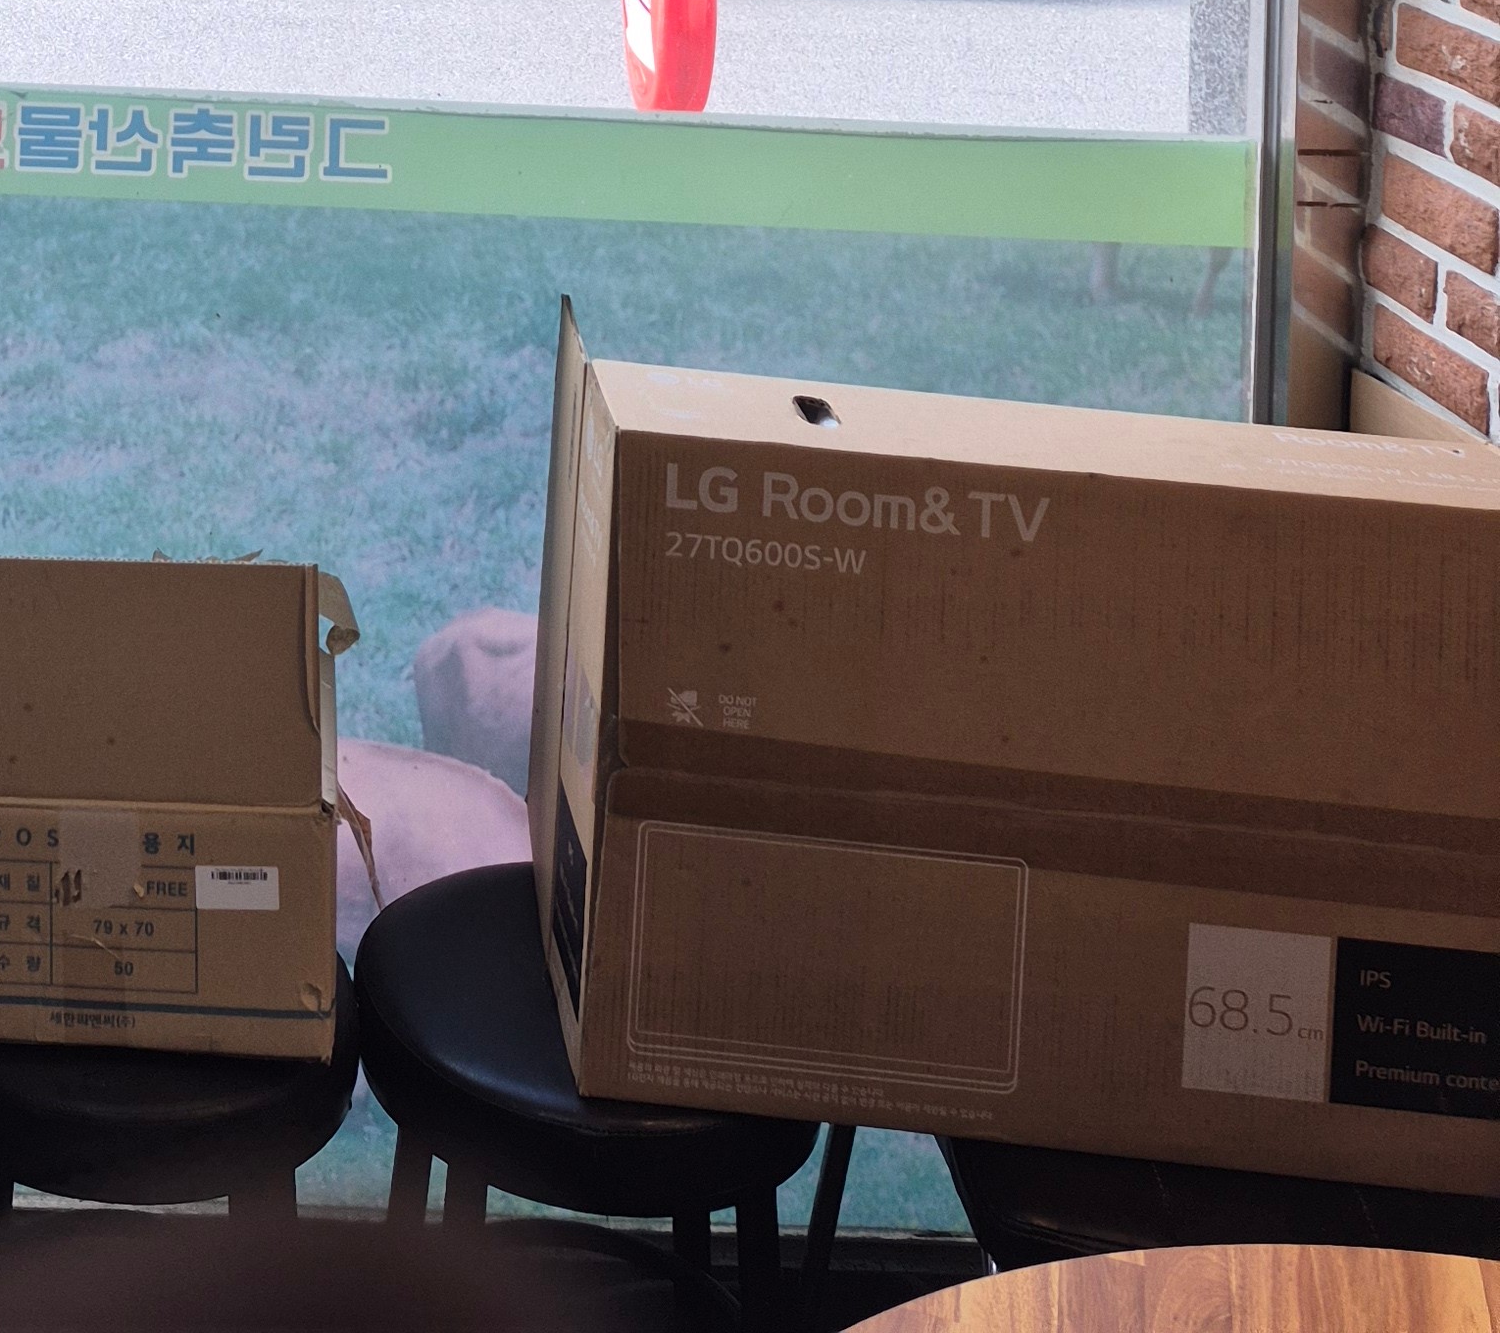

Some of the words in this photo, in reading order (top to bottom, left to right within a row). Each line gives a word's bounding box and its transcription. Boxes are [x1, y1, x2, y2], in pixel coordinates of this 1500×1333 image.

[666, 463, 738, 513] LG
[967, 492, 1051, 543] TV
[665, 531, 867, 576] 27TQ600S-W
[147, 882, 187, 896] FREE
[1360, 969, 1391, 988] IPS
[1188, 986, 1293, 1036] 68.5
[1357, 1014, 1410, 1034] Wi-Fi
[1417, 1022, 1486, 1044] Built-in
[1355, 1060, 1439, 1085] Premium
